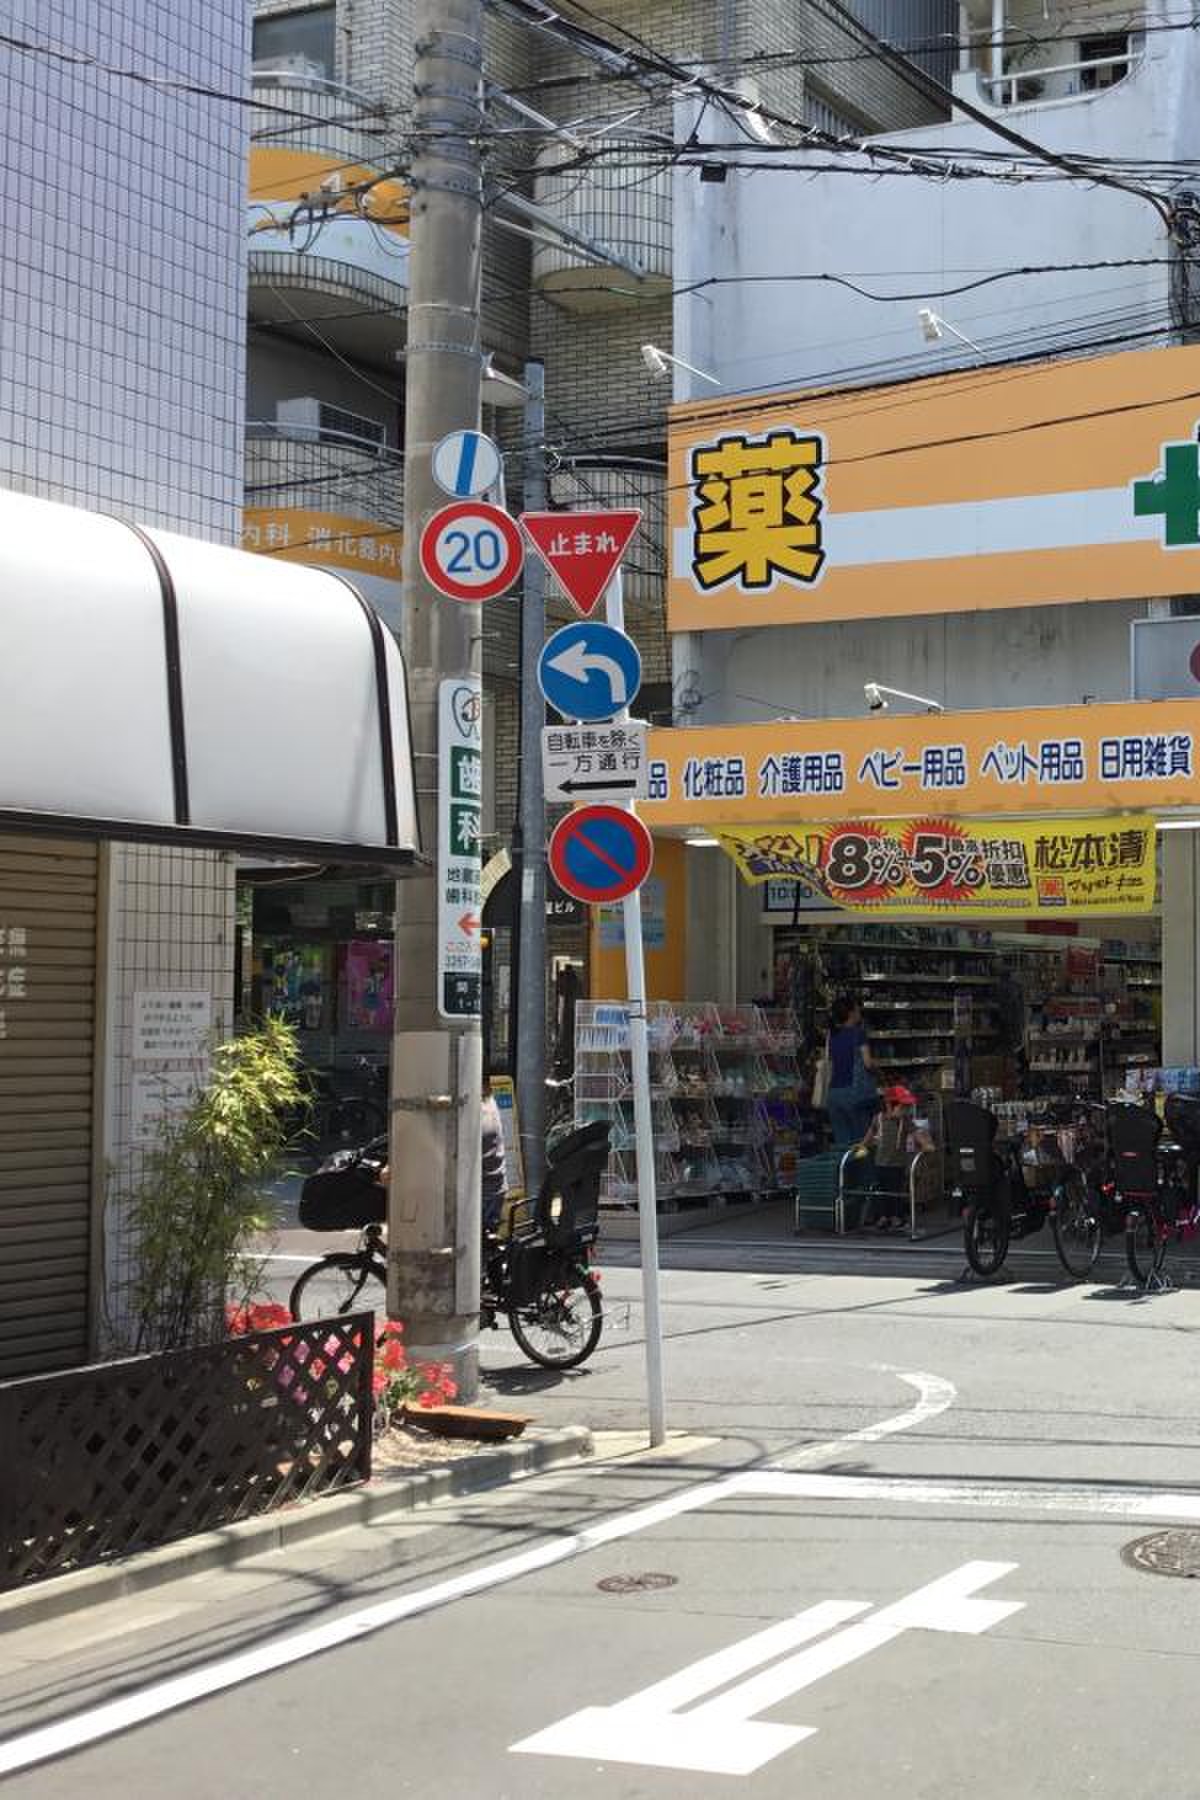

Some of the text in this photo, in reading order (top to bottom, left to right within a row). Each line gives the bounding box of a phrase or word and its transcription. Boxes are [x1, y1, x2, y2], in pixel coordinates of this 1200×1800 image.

[692, 431, 825, 590] 薬
[444, 530, 501, 573] 20
[548, 531, 621, 557] 止まれ
[547, 729, 640, 752] 自転車を除く
[548, 752, 641, 773] 一方通行
[684, 760, 745, 798] 化粧品
[760, 753, 844, 795] 介護用品
[860, 747, 966, 788] ベビー用品
[981, 741, 1084, 782] ペット用品
[1101, 735, 1192, 779] 日用雑貨
[1034, 829, 1147, 870] 松本清
